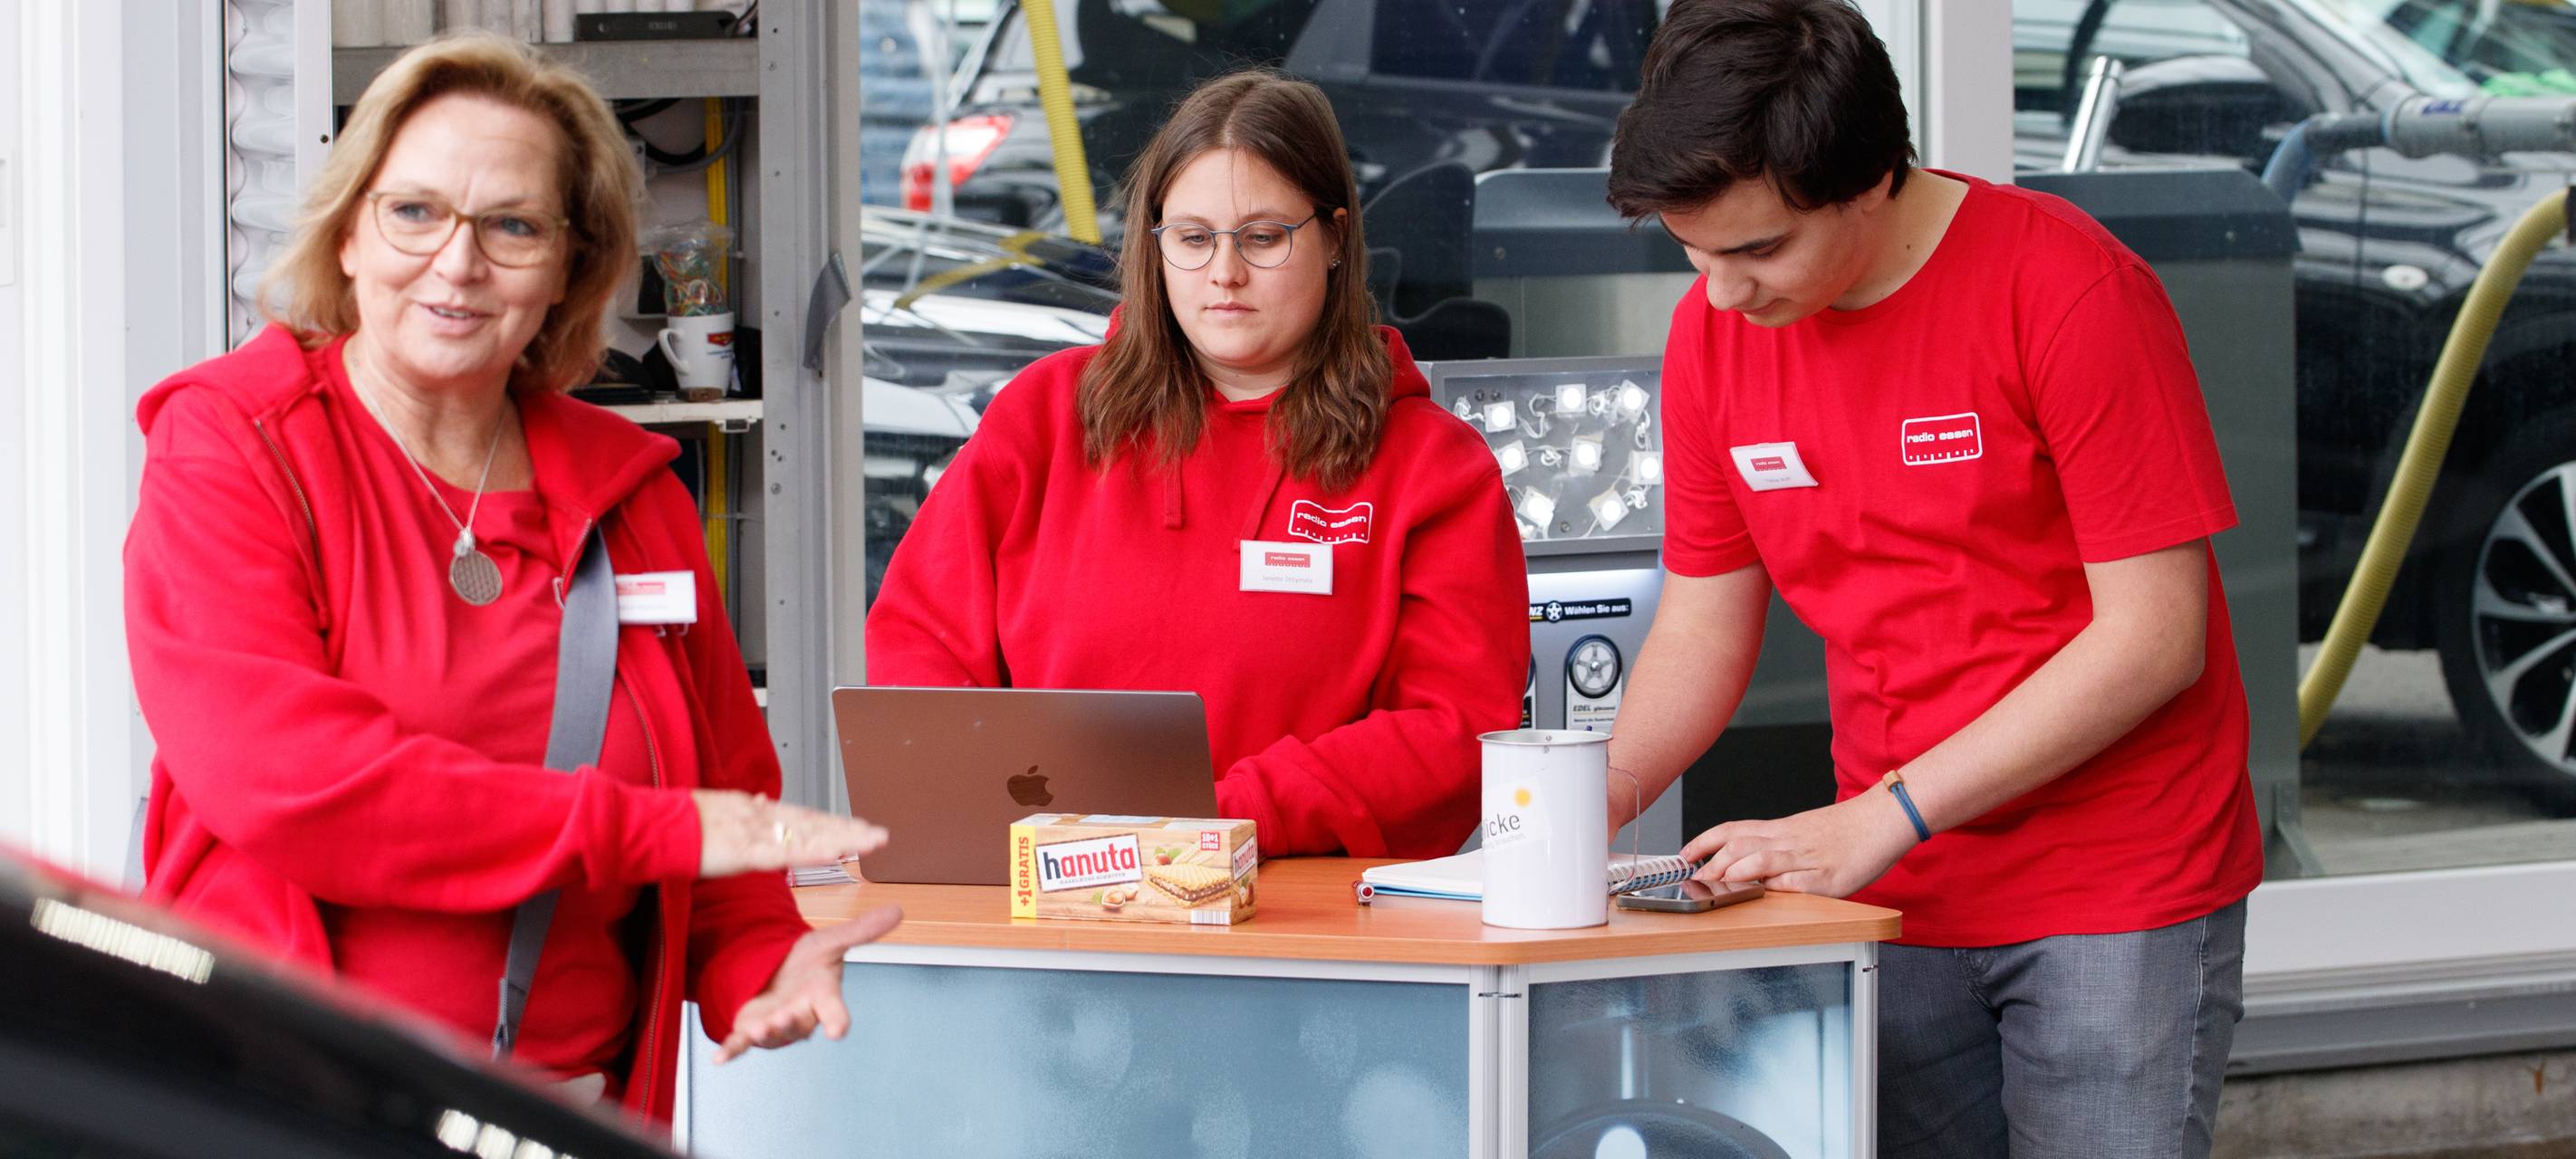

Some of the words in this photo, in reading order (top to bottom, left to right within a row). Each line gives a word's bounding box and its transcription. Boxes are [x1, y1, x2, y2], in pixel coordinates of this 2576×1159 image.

[1907, 432, 1935, 444] radio
[1939, 428, 1974, 441] essen
[1296, 512, 1327, 528] radio
[1330, 515, 1367, 529] essen
[1564, 605, 1596, 617] Wählen
[1597, 603, 1610, 614] Sie
[1572, 704, 1591, 713] EDEL
[1043, 842, 1136, 881] hanuta
[1235, 842, 1255, 874] hanuta
